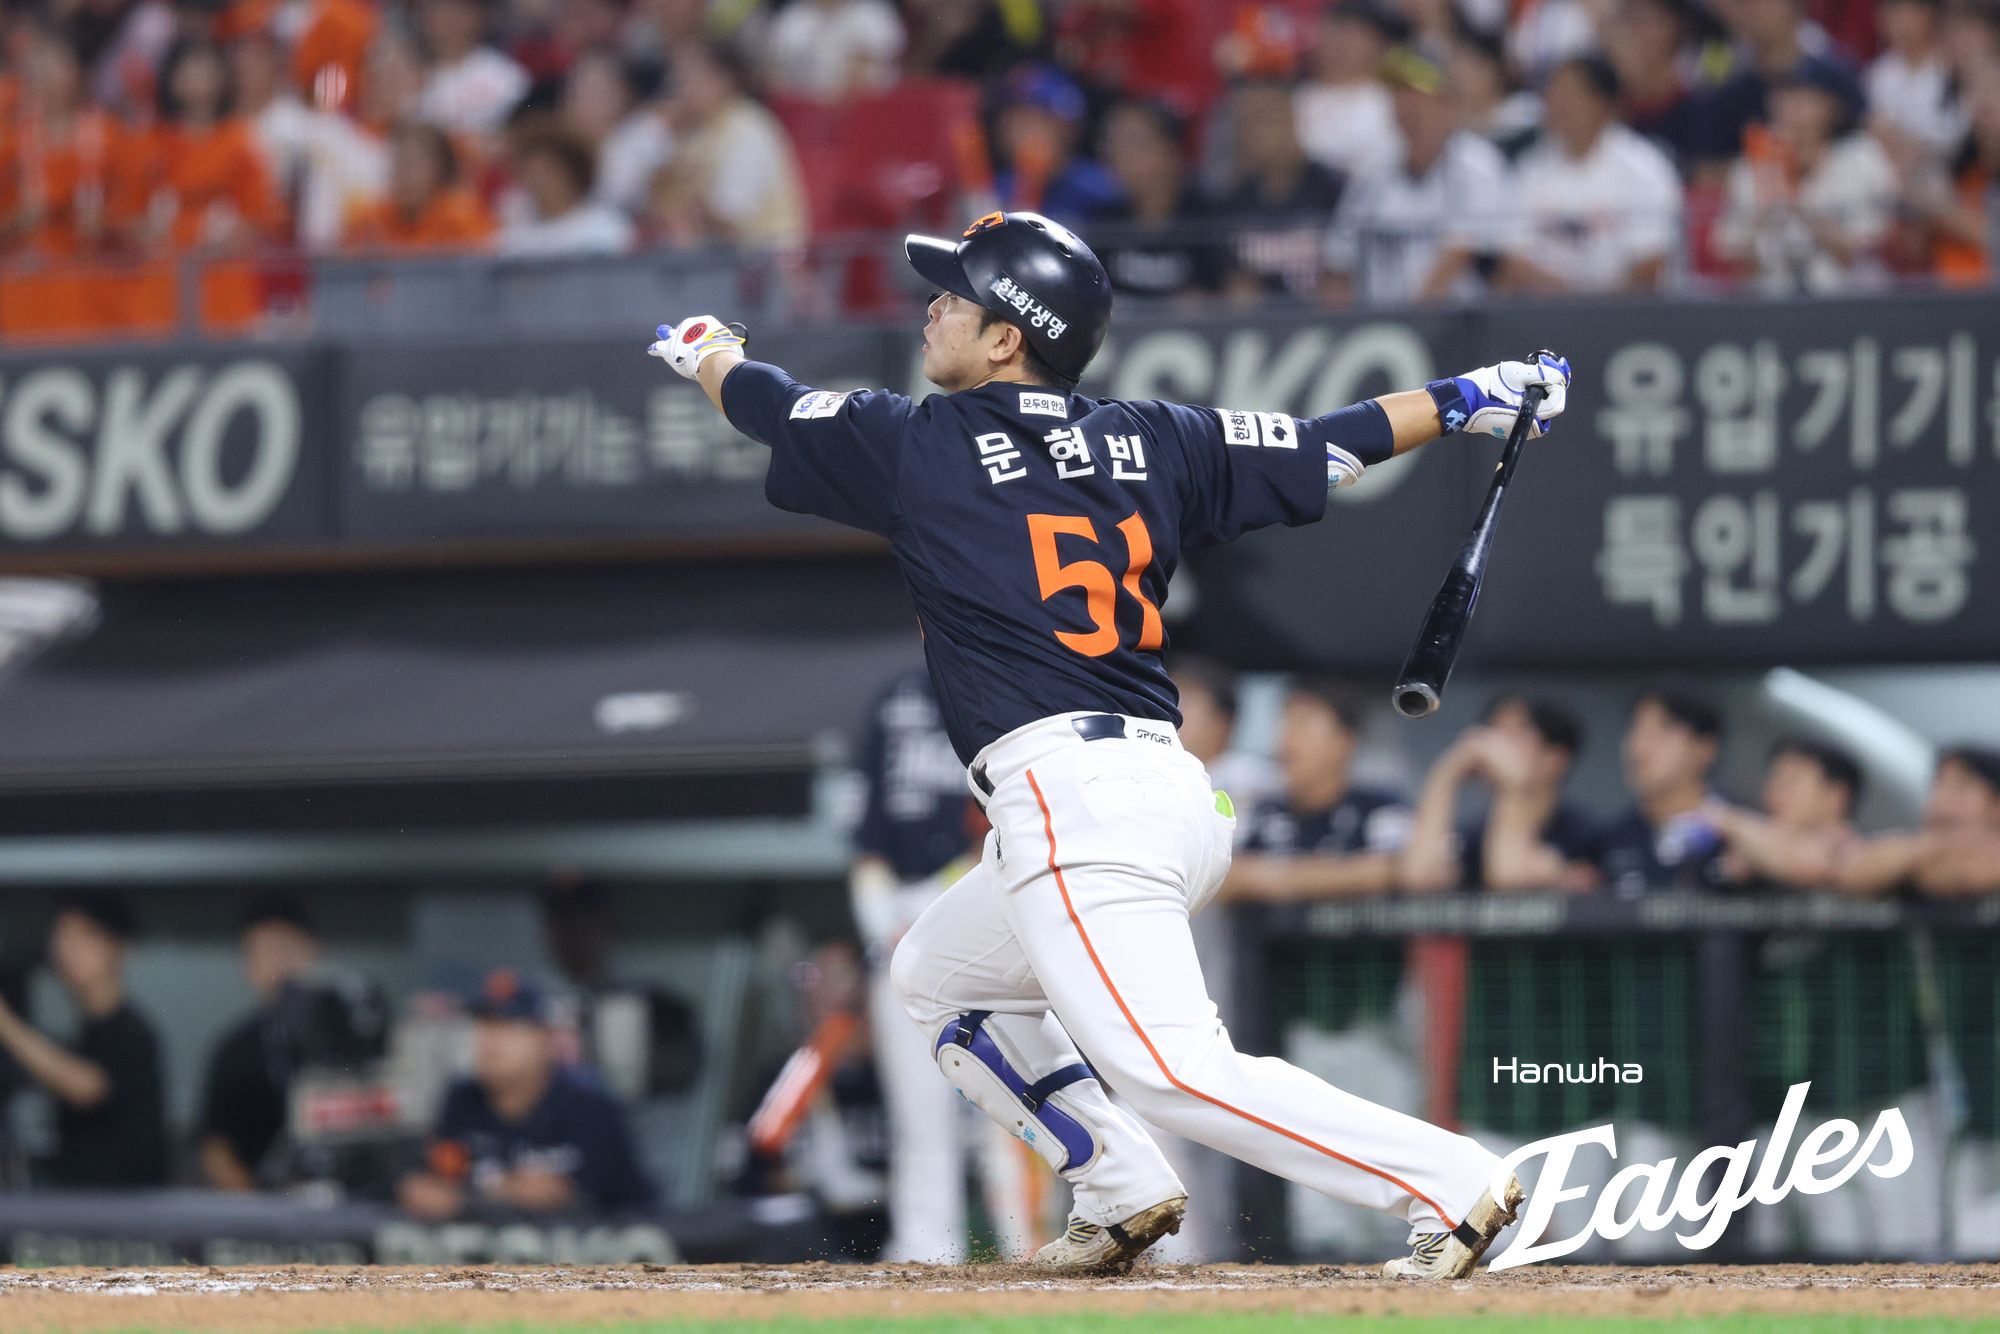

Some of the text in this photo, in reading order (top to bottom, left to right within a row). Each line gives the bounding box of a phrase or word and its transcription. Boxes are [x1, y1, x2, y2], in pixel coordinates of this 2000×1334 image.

[995, 277, 1068, 340] 한화생명
[1022, 398, 1049, 410] 모두의
[1595, 333, 2000, 477] 유압기기
[1026, 510, 1163, 657] 51
[1594, 487, 1976, 625] 특인기공
[1137, 729, 1171, 746] SPYDER
